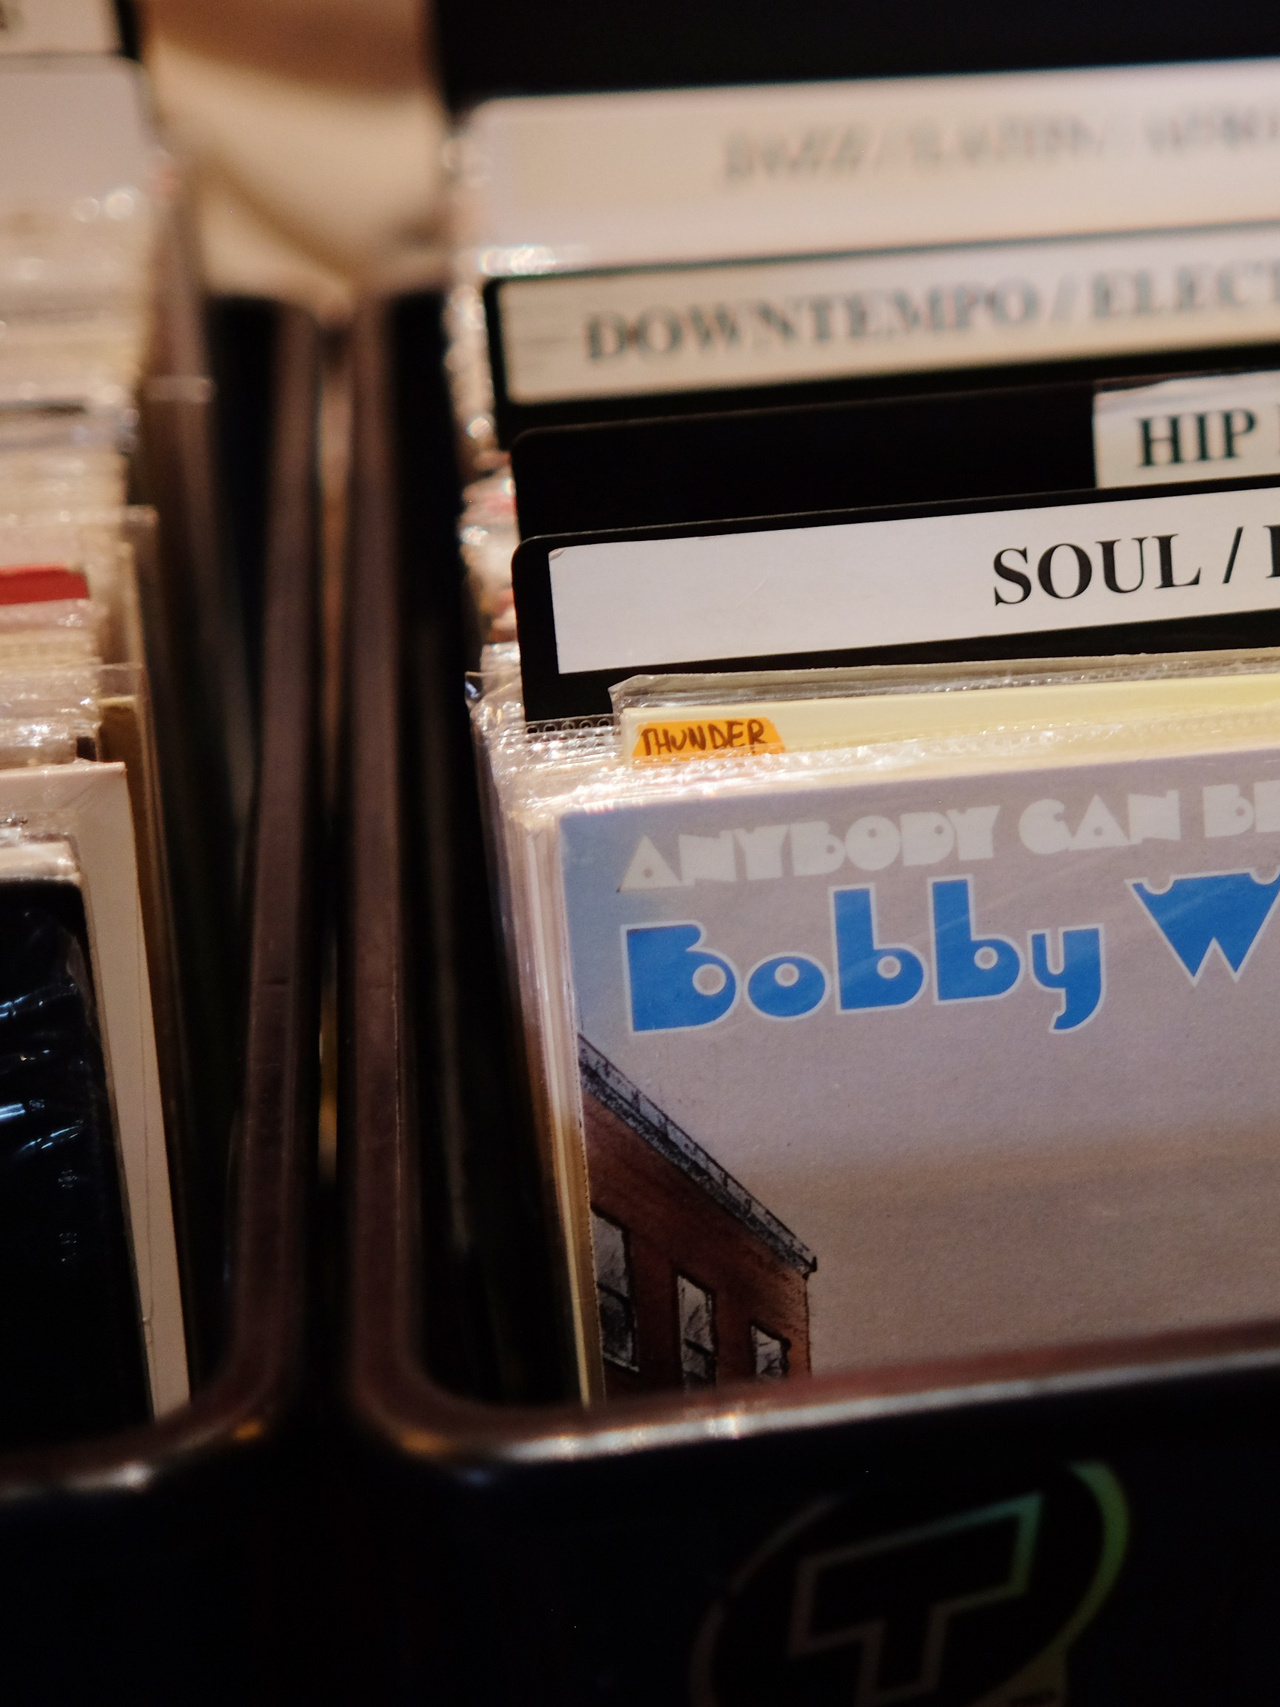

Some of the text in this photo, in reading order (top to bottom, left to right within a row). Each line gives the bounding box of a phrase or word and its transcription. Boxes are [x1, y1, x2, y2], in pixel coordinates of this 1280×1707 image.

[584, 274, 1040, 362] DOWNTEMPO
[1138, 409, 1257, 468] HIP
[992, 532, 1201, 606] SOUL
[1221, 526, 1247, 583] /
[641, 719, 767, 756] THUNDER
[616, 804, 1001, 892] ANYBODY
[1018, 789, 1181, 855] CAN
[620, 874, 1104, 1036] Bobby
